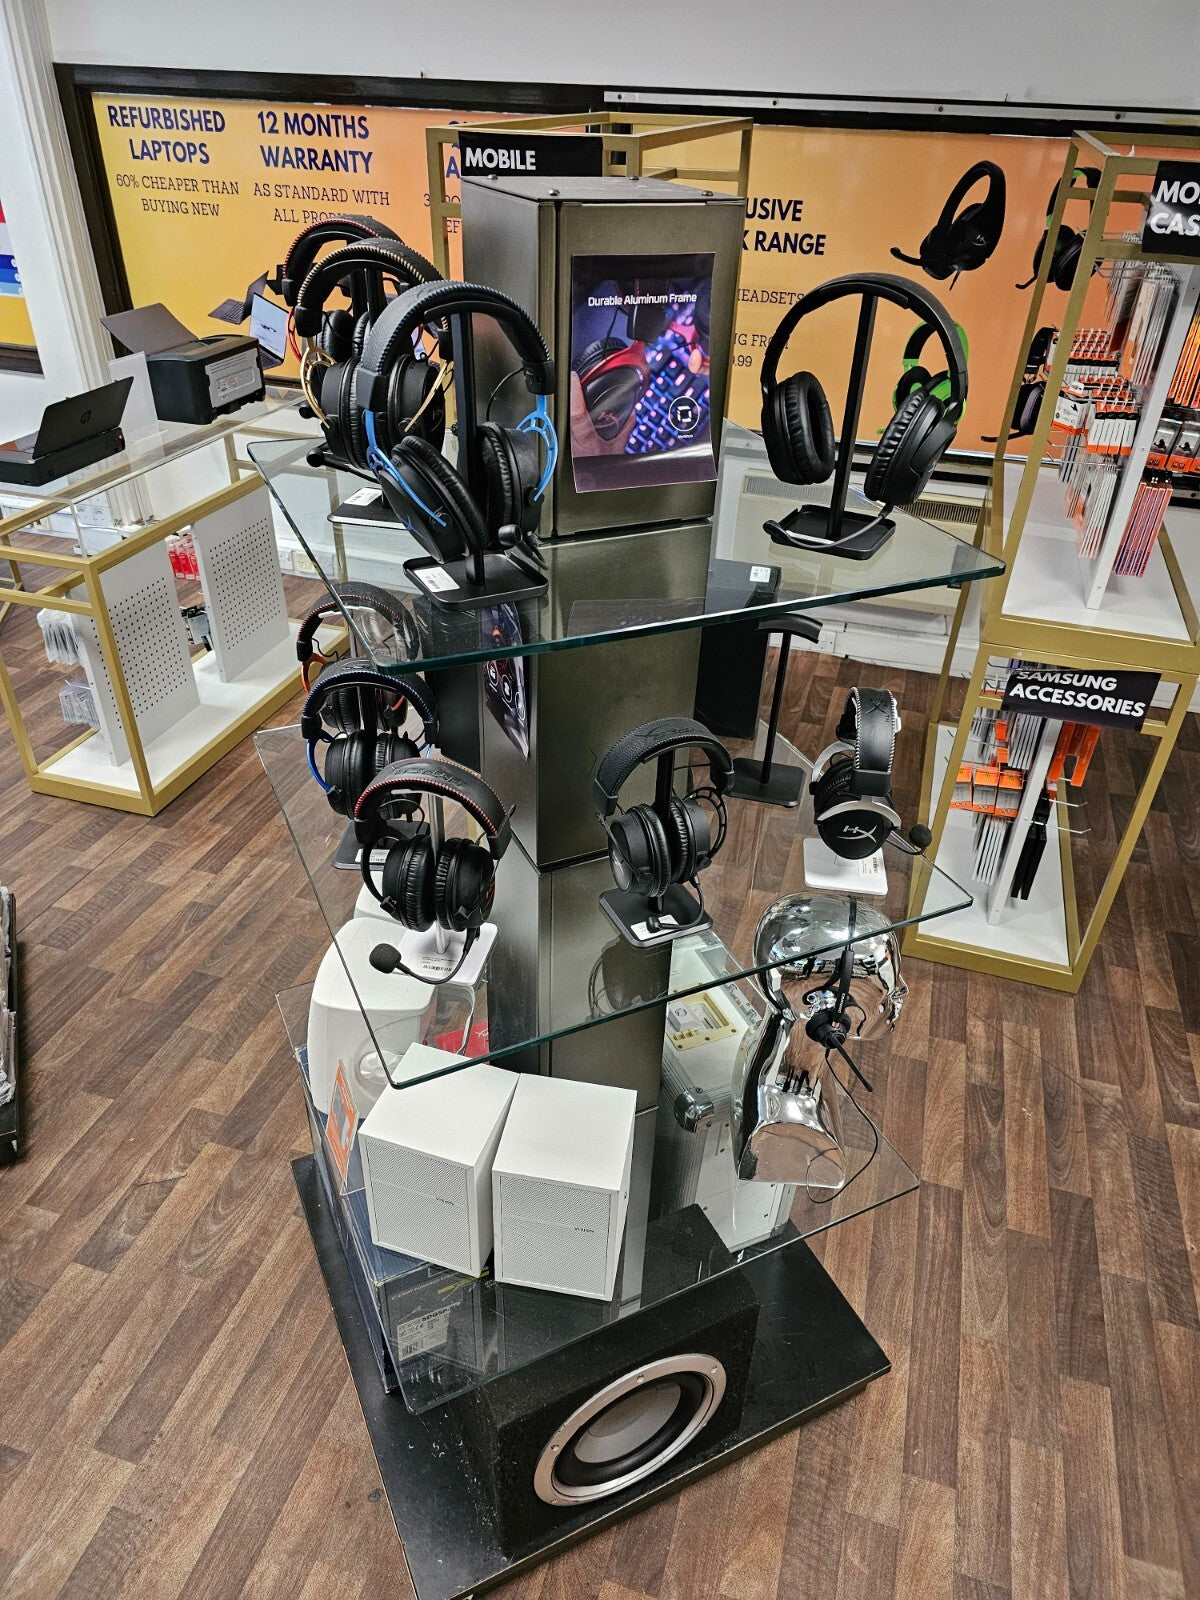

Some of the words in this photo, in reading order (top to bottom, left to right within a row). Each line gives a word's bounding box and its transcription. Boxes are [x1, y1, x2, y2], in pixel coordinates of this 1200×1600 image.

[107, 105, 226, 133] REFURBISHED
[258, 110, 279, 134] 12
[284, 112, 370, 139] MONTHS
[129, 139, 210, 164] LAPTOPS
[260, 145, 373, 174] WARRANTY
[465, 147, 536, 170] MOBILE
[116, 174, 139, 188] 60%
[142, 176, 199, 192] CHEAPER
[202, 179, 239, 195] THAN
[253, 182, 271, 197] AS
[274, 184, 349, 203] STANDARD
[352, 189, 390, 206] WITH
[1155, 180, 1200, 205] MO
[141, 198, 189, 215] BUYING
[191, 202, 220, 217] NEW
[274, 208, 300, 223] ALL
[746, 198, 803, 222] USIVE
[1150, 212, 1200, 237] CAS
[755, 230, 827, 256] RANGE
[588, 295, 622, 307] Durable
[624, 293, 668, 305] Aluminum
[669, 293, 698, 303] Frame
[1016, 670, 1118, 691] SAMSUNG
[1009, 683, 1147, 717] ACCESSORIES
